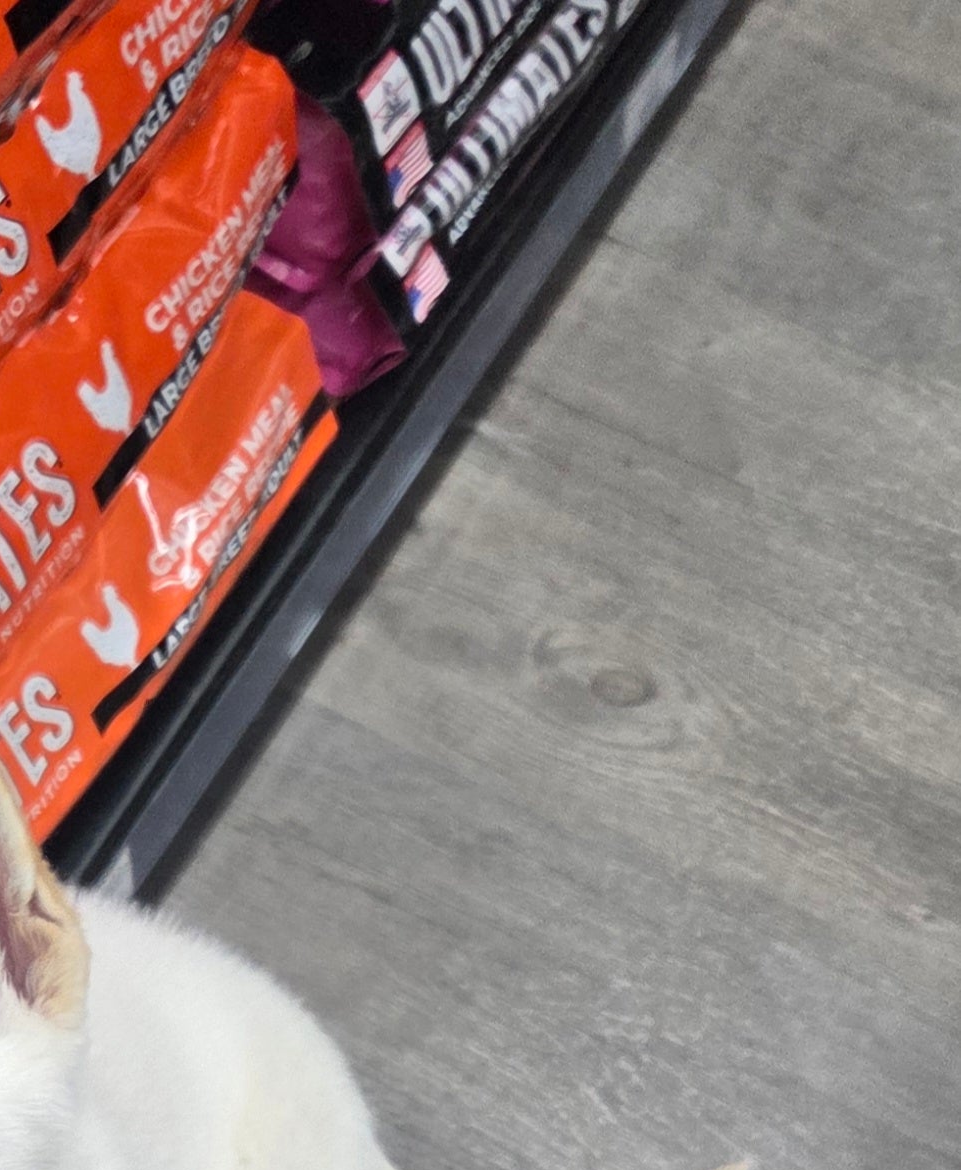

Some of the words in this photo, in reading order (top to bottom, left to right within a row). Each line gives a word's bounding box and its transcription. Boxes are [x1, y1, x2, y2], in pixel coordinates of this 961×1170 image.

[107, 92, 173, 188] LARGE
[143, 205, 244, 334] CHICKEN
[143, 349, 199, 440] LARGE
